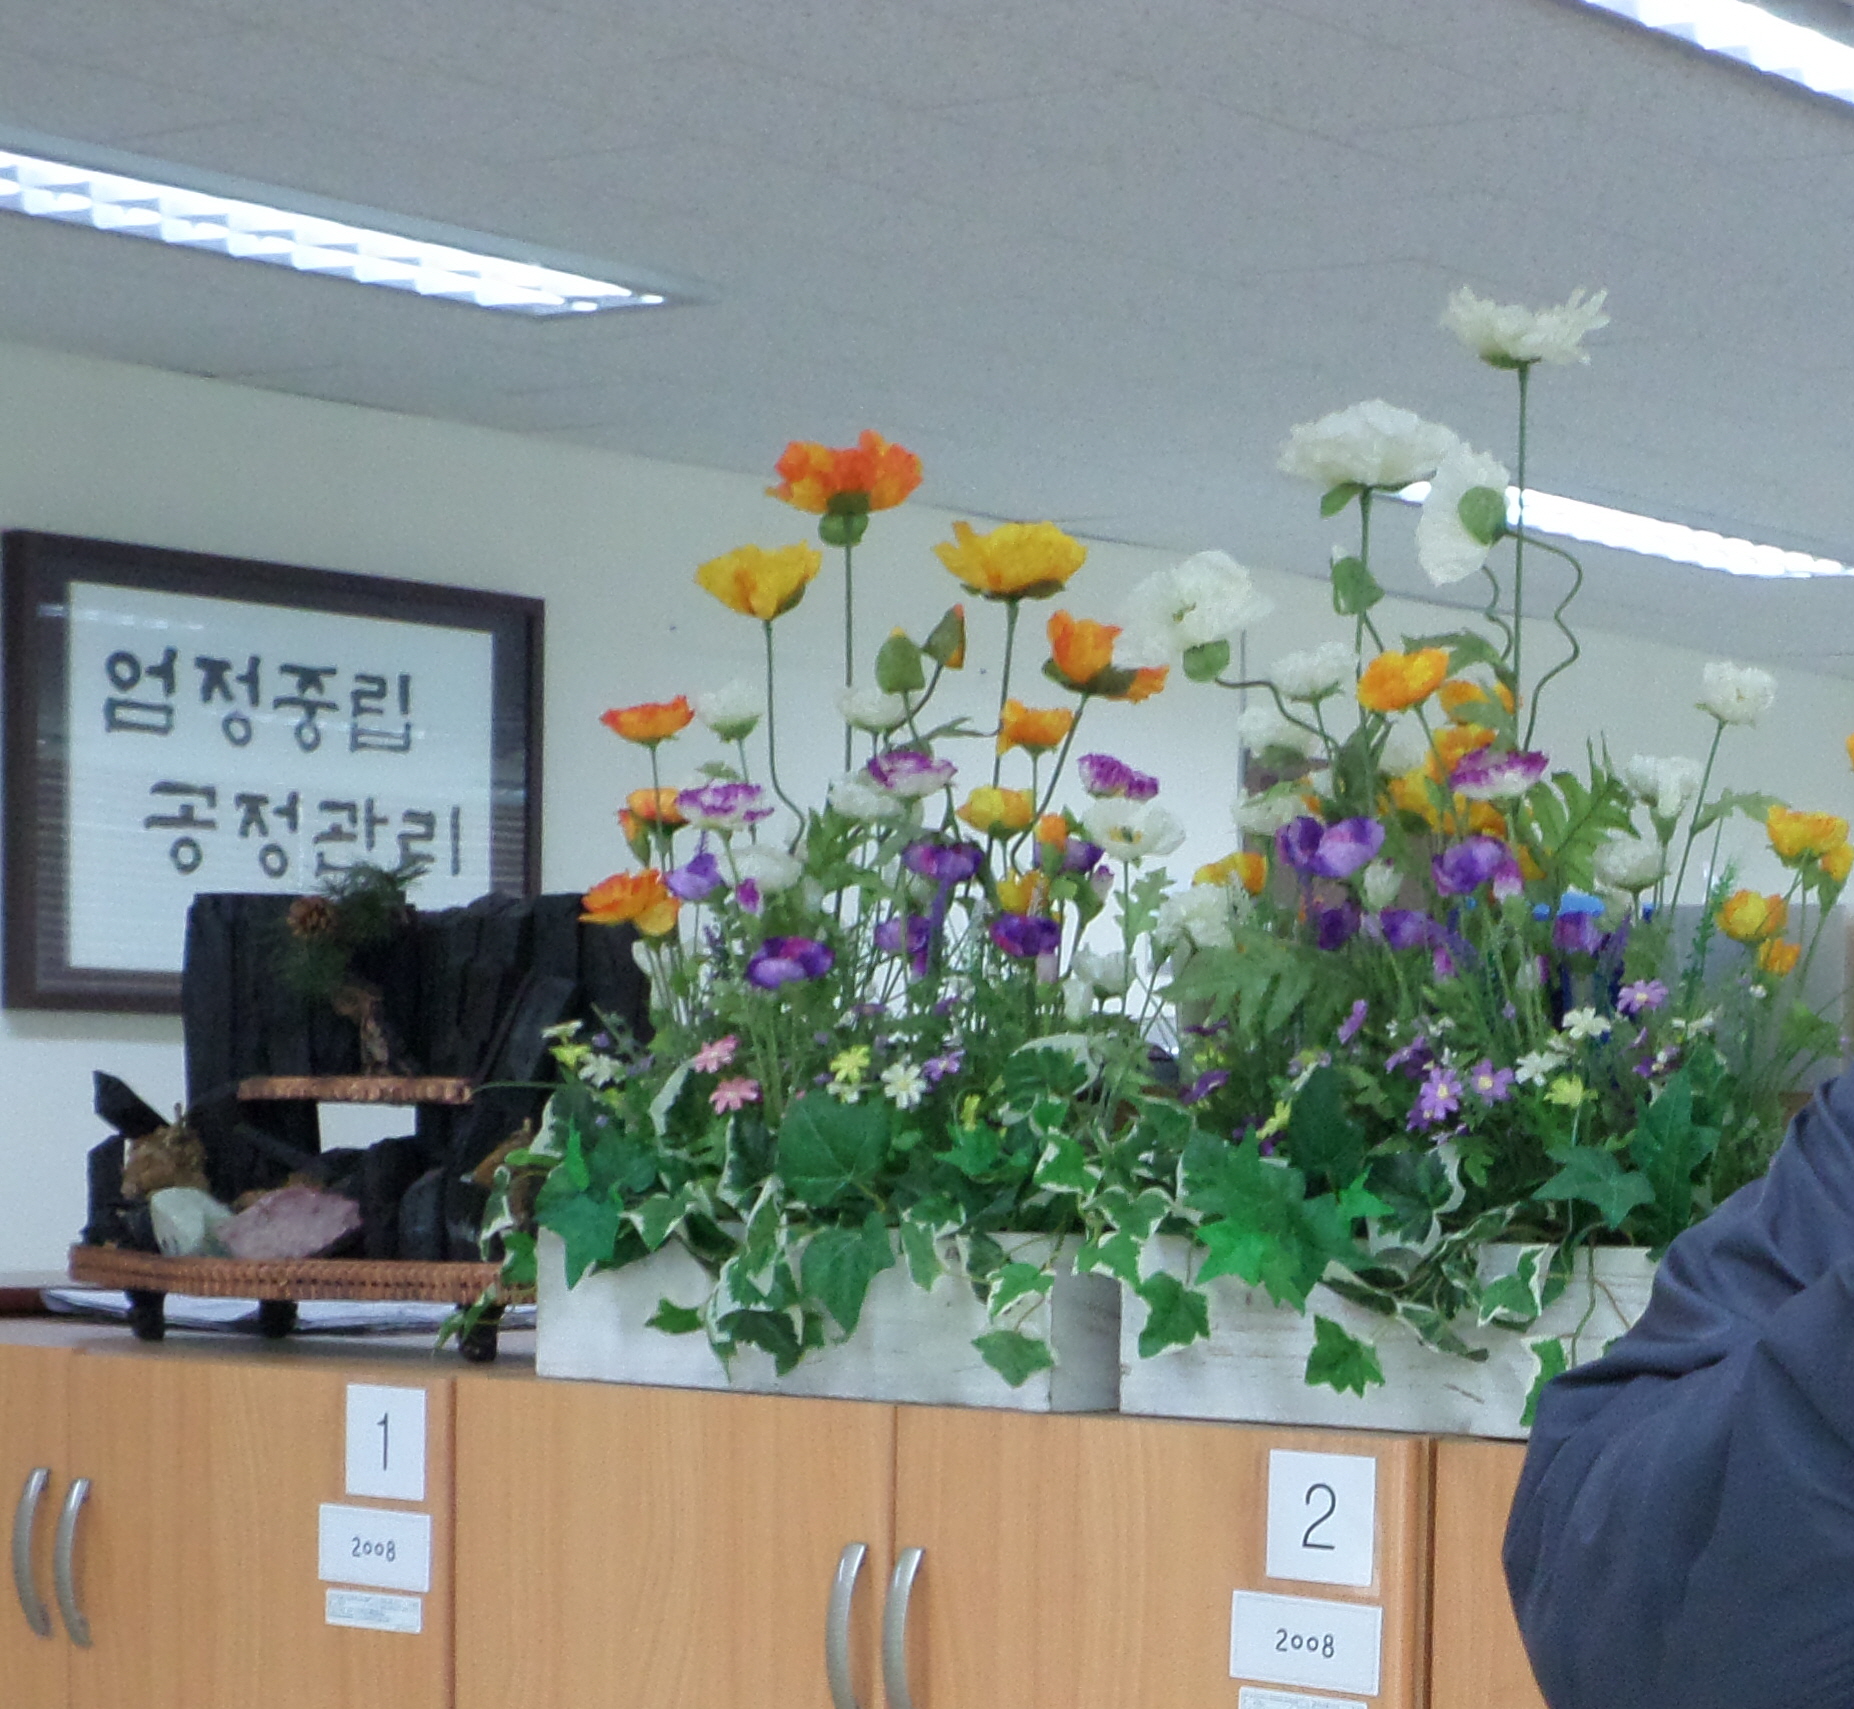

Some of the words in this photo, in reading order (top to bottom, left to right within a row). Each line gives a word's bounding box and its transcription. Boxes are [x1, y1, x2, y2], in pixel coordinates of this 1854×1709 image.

[104, 647, 412, 754] 엄정중립
[144, 780, 462, 879] 공정관리
[376, 1412, 389, 1471] 1
[1302, 1483, 1337, 1551] 2
[351, 1537, 396, 1563] 2008
[1275, 1628, 1335, 1659] 2008
